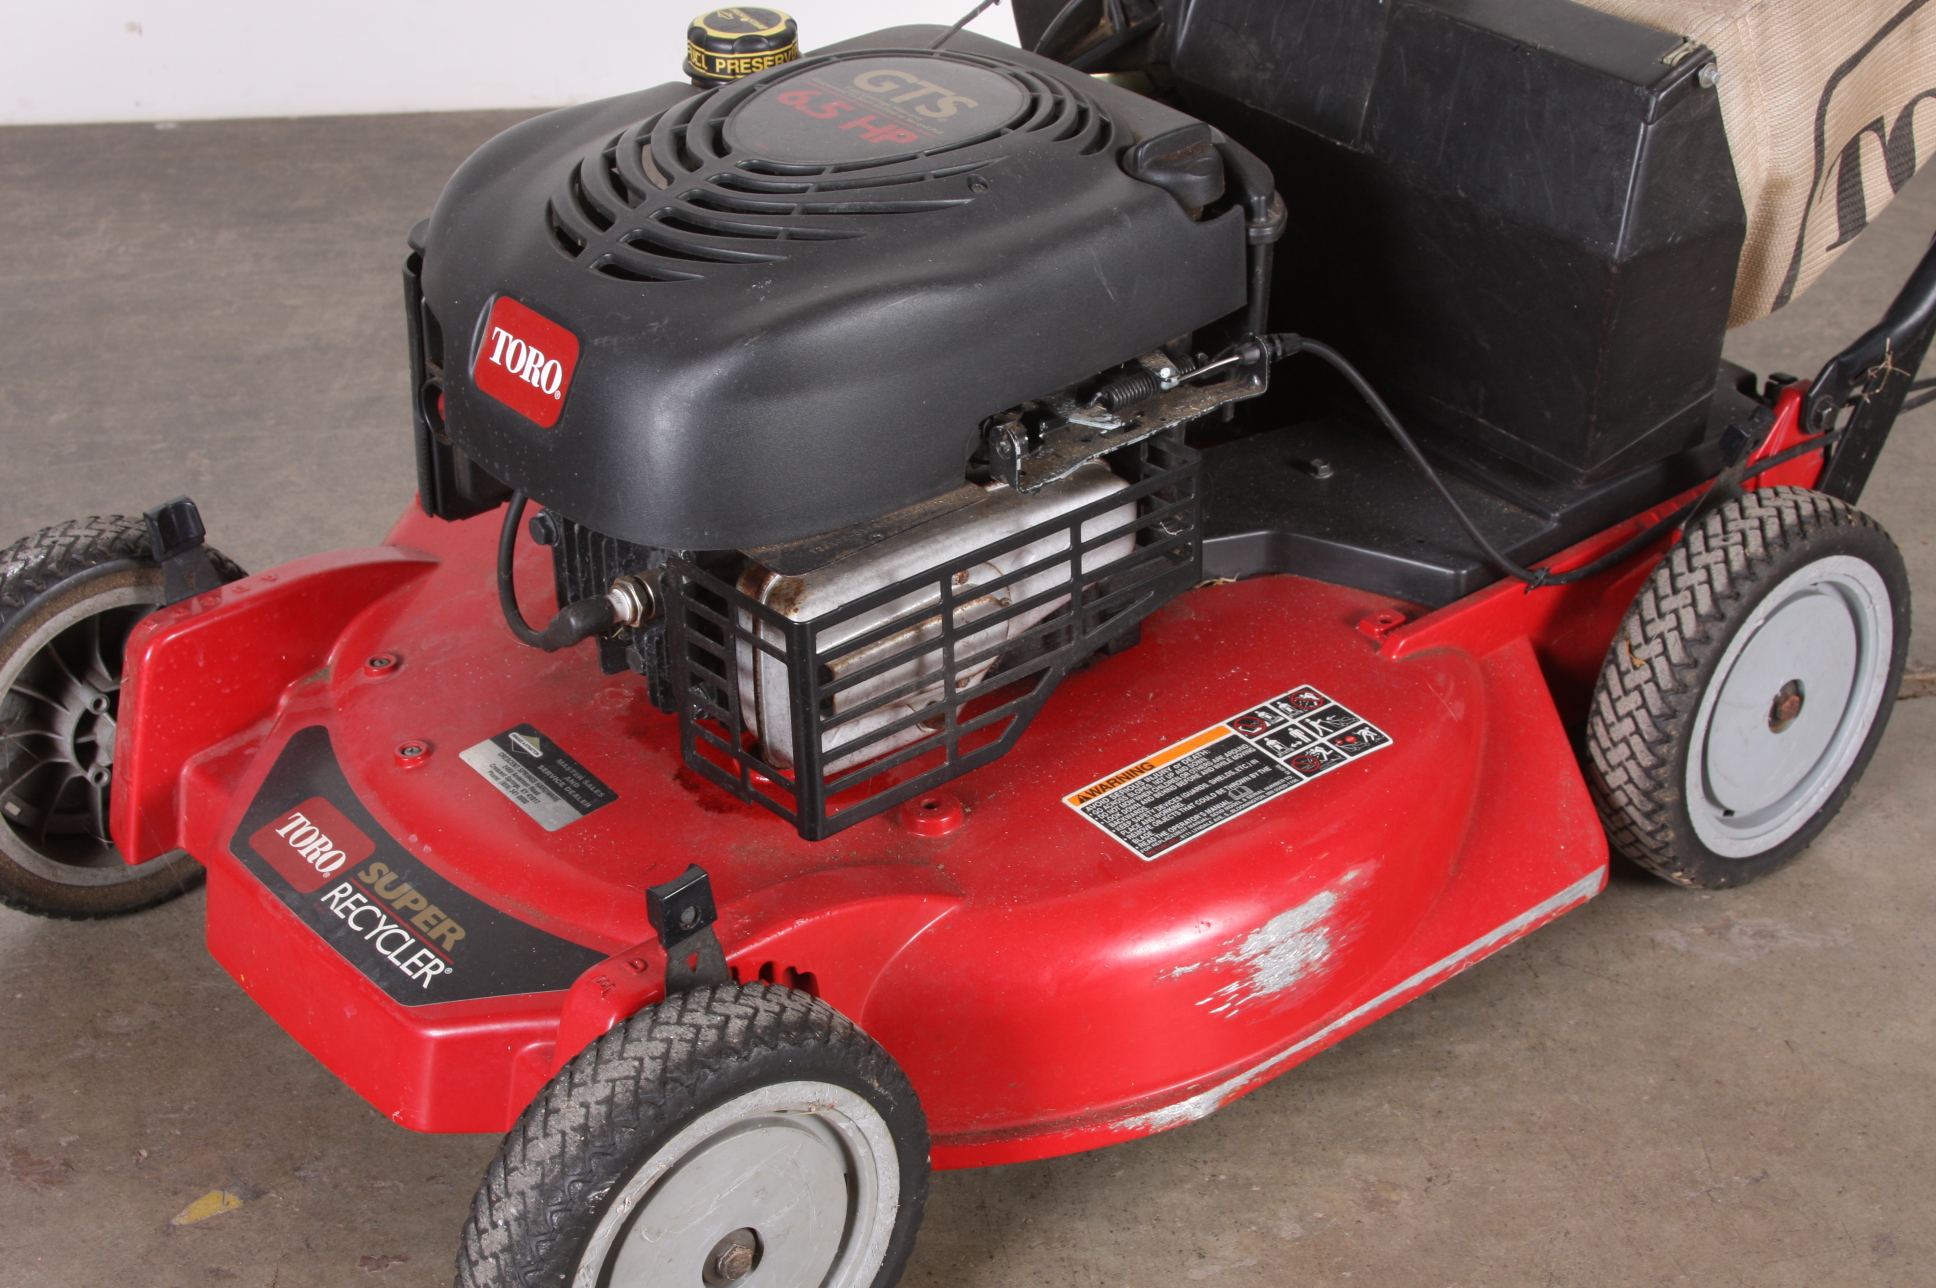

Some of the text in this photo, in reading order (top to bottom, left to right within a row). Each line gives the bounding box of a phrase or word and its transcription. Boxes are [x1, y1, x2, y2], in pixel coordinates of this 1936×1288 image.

[777, 90, 918, 144] 6.5 HP
[853, 69, 979, 118] GTS
[489, 326, 563, 395] TORO
[537, 765, 591, 808] SERVICE DEALER
[556, 759, 605, 797] MASTER SALES
[564, 776, 581, 788] AND
[1084, 797, 1110, 811] AVOID
[1109, 781, 1145, 799] SERIOUS
[1143, 767, 1173, 782] INJURY
[1181, 749, 1211, 765] DEATH:
[1085, 762, 1155, 800] WARNING
[1102, 795, 1129, 810] ACROSS
[1152, 777, 1167, 785] NOT
[1174, 766, 1189, 774] AND
[1103, 747, 1257, 823] LOOK DOWN AND BEHIND BEFORE AND WHILE MOVING
[1107, 806, 1121, 814] NOT
[1119, 799, 1136, 808] MOW
[1134, 790, 1153, 801] WHEN
[1151, 776, 1182, 792] CHILDREN
[1188, 761, 1214, 774] OTHERS
[1211, 755, 1226, 763] ARE
[1126, 824, 1154, 839] REMOVE
[1151, 811, 1182, 827] OBJECTS
[1178, 803, 1196, 813] THAT
[1194, 792, 1218, 805] COULD
[1223, 776, 1252, 791] THROWN
[1256, 766, 1272, 775] THE
[1114, 820, 1134, 831] KEEP
[1131, 809, 1157, 822] SAFETY
[1154, 796, 1183, 811] DEVICES
[1120, 823, 1143, 835] PLACE
[1140, 816, 1156, 825] AND
[1138, 837, 1158, 848] READ
[1154, 831, 1170, 839] THE
[1166, 812, 1208, 833] OPERATOR'S
[275, 811, 347, 874] TORO
[357, 861, 466, 952] SUPER
[320, 882, 445, 989] RECYCLER
